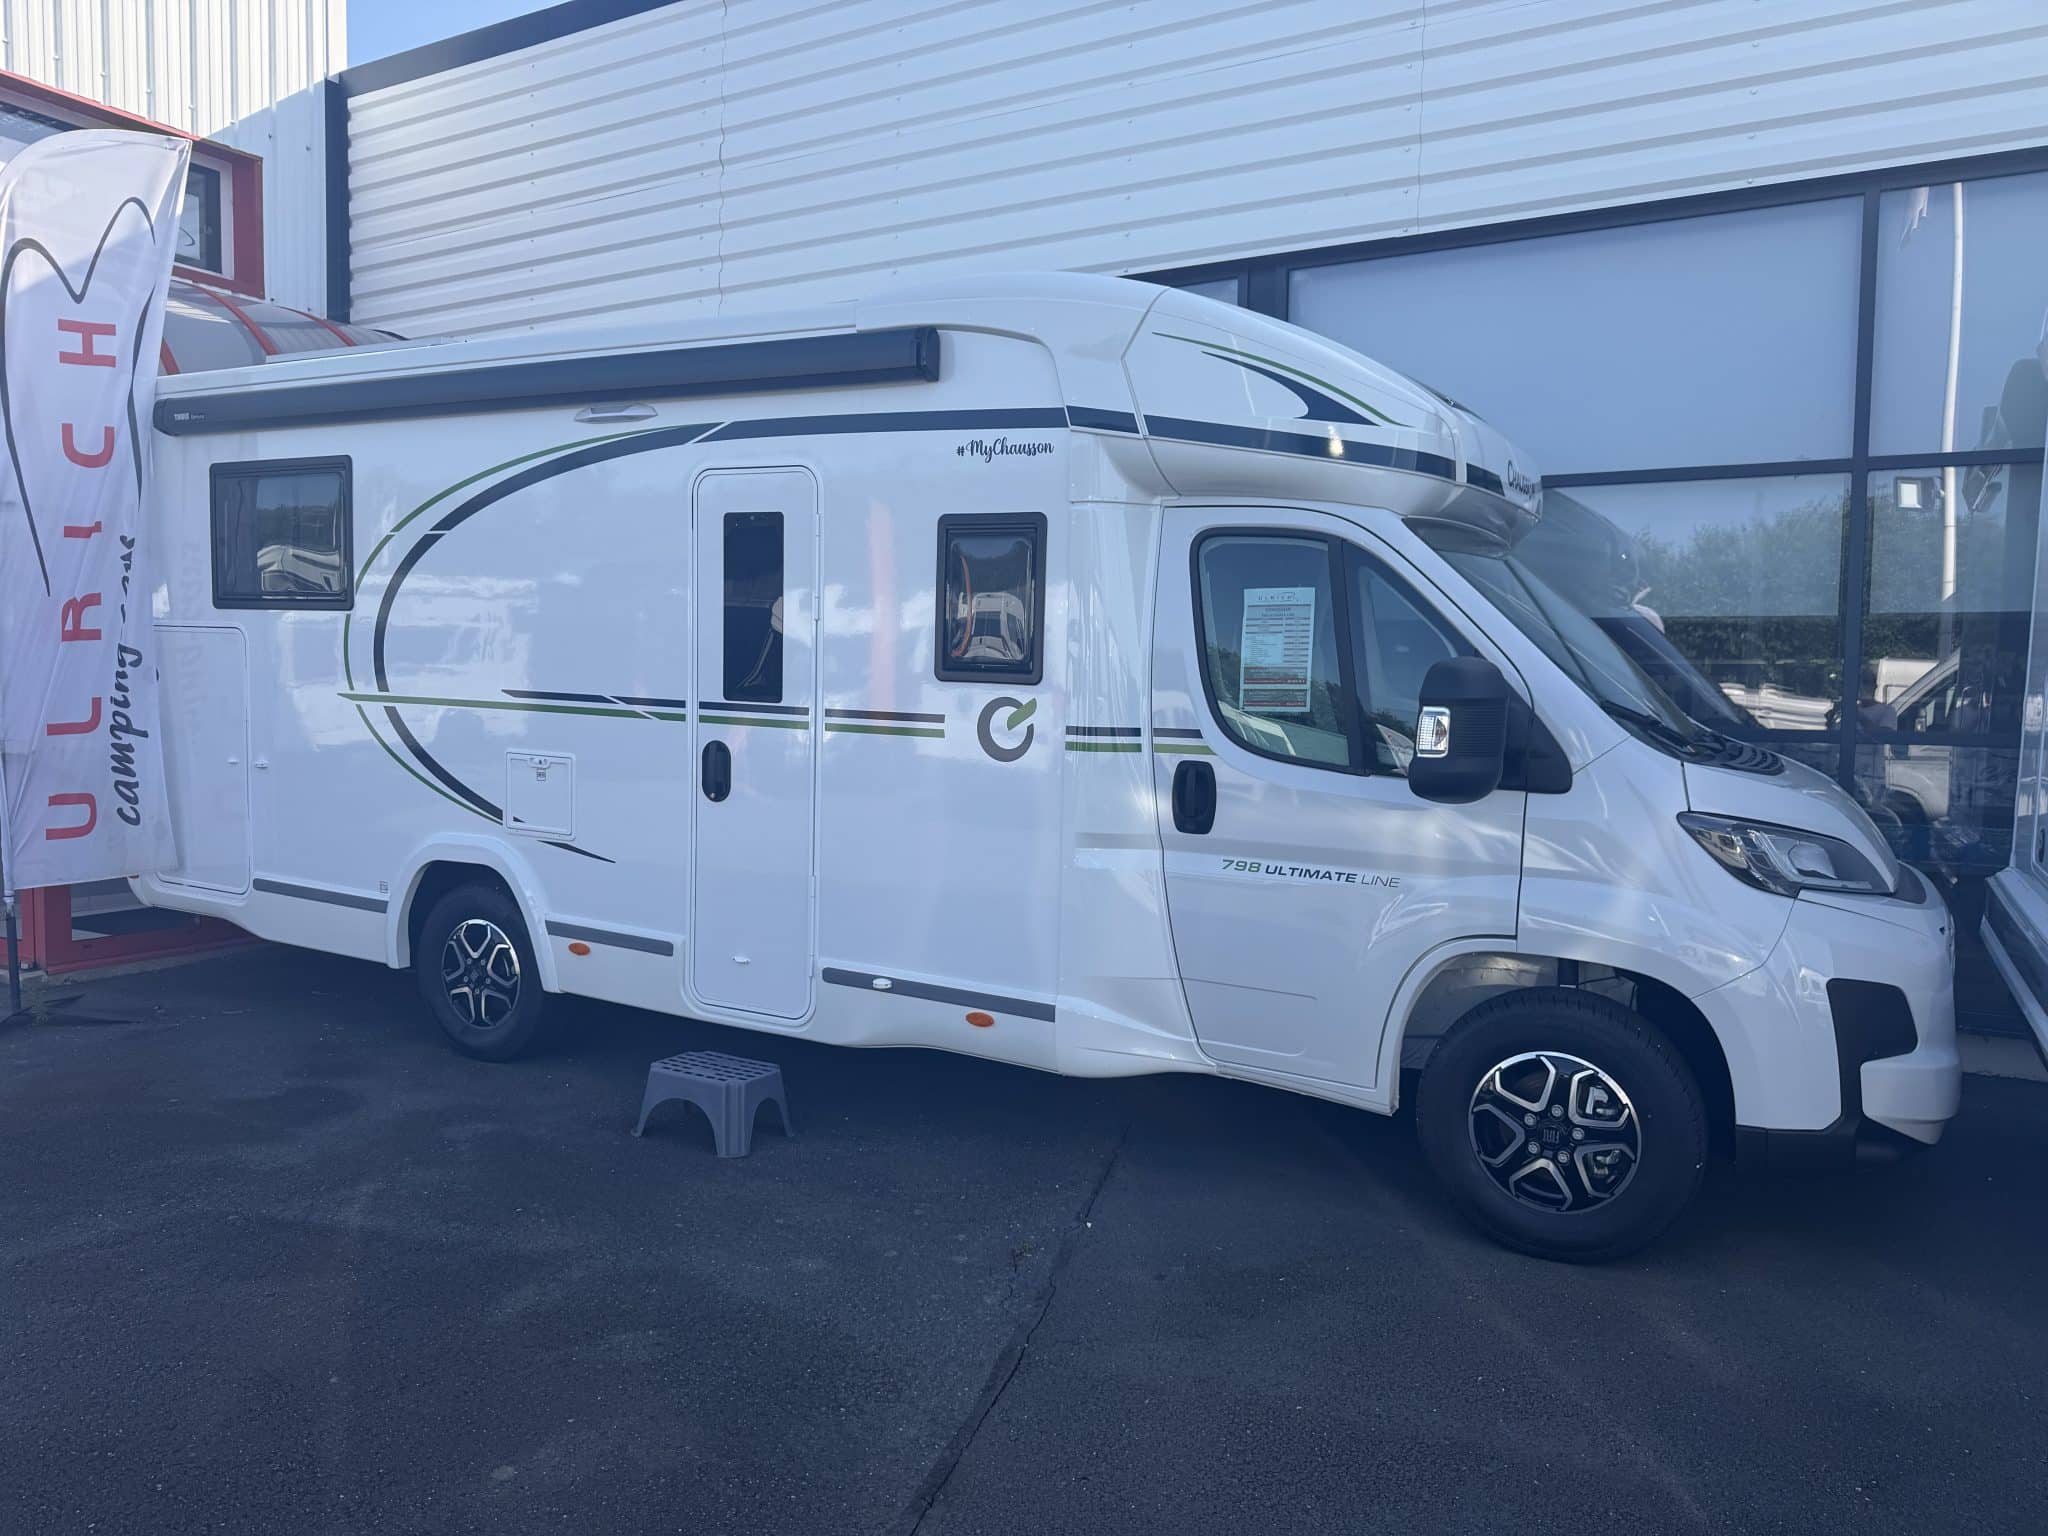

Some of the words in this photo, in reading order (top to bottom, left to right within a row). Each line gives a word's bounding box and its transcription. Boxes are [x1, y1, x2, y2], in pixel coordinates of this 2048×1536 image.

[956, 436, 1054, 464] #MyChausson
[45, 318, 117, 841] ULRICH
[1222, 858, 1262, 873] 798
[1265, 864, 1358, 884] ULTIMATE
[1361, 873, 1401, 889] LINE
